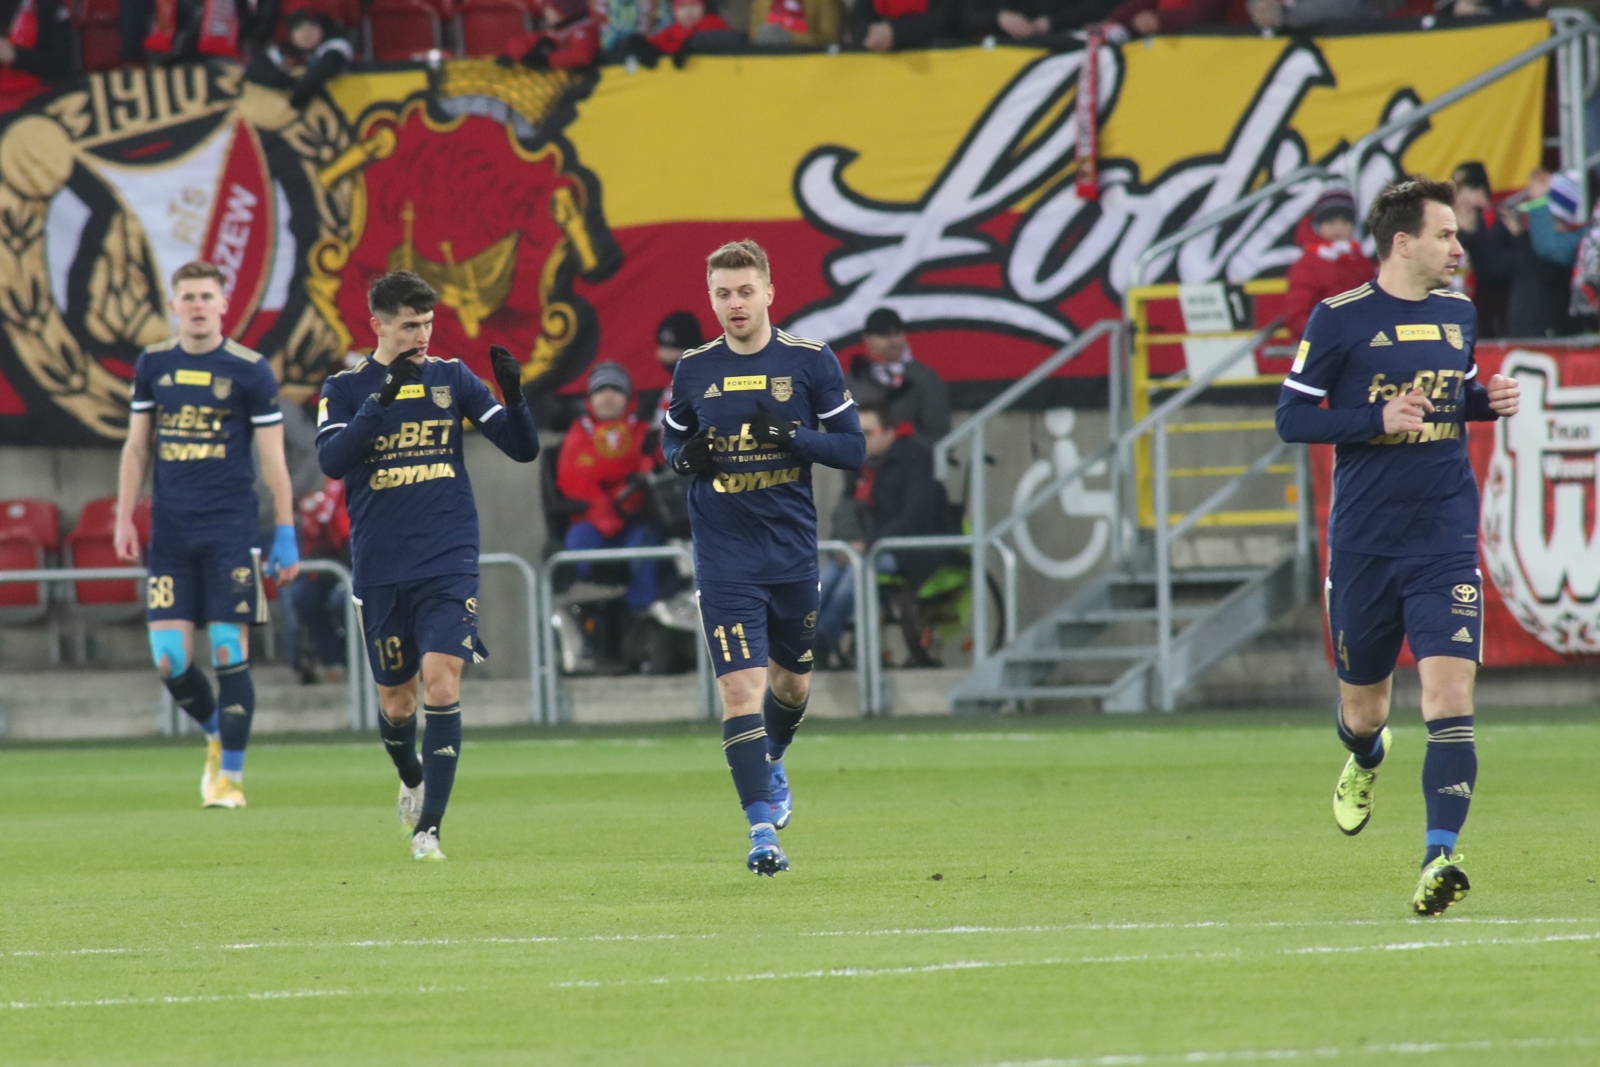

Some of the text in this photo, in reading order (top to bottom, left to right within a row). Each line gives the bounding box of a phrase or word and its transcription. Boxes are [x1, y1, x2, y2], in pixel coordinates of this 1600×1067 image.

[373, 420, 453, 451] orBET
[369, 463, 456, 490] GDYNIA
[712, 467, 800, 493] GDYNIA
[375, 635, 403, 671] 19
[713, 623, 750, 662] 11
[1338, 629, 1350, 671] 4
